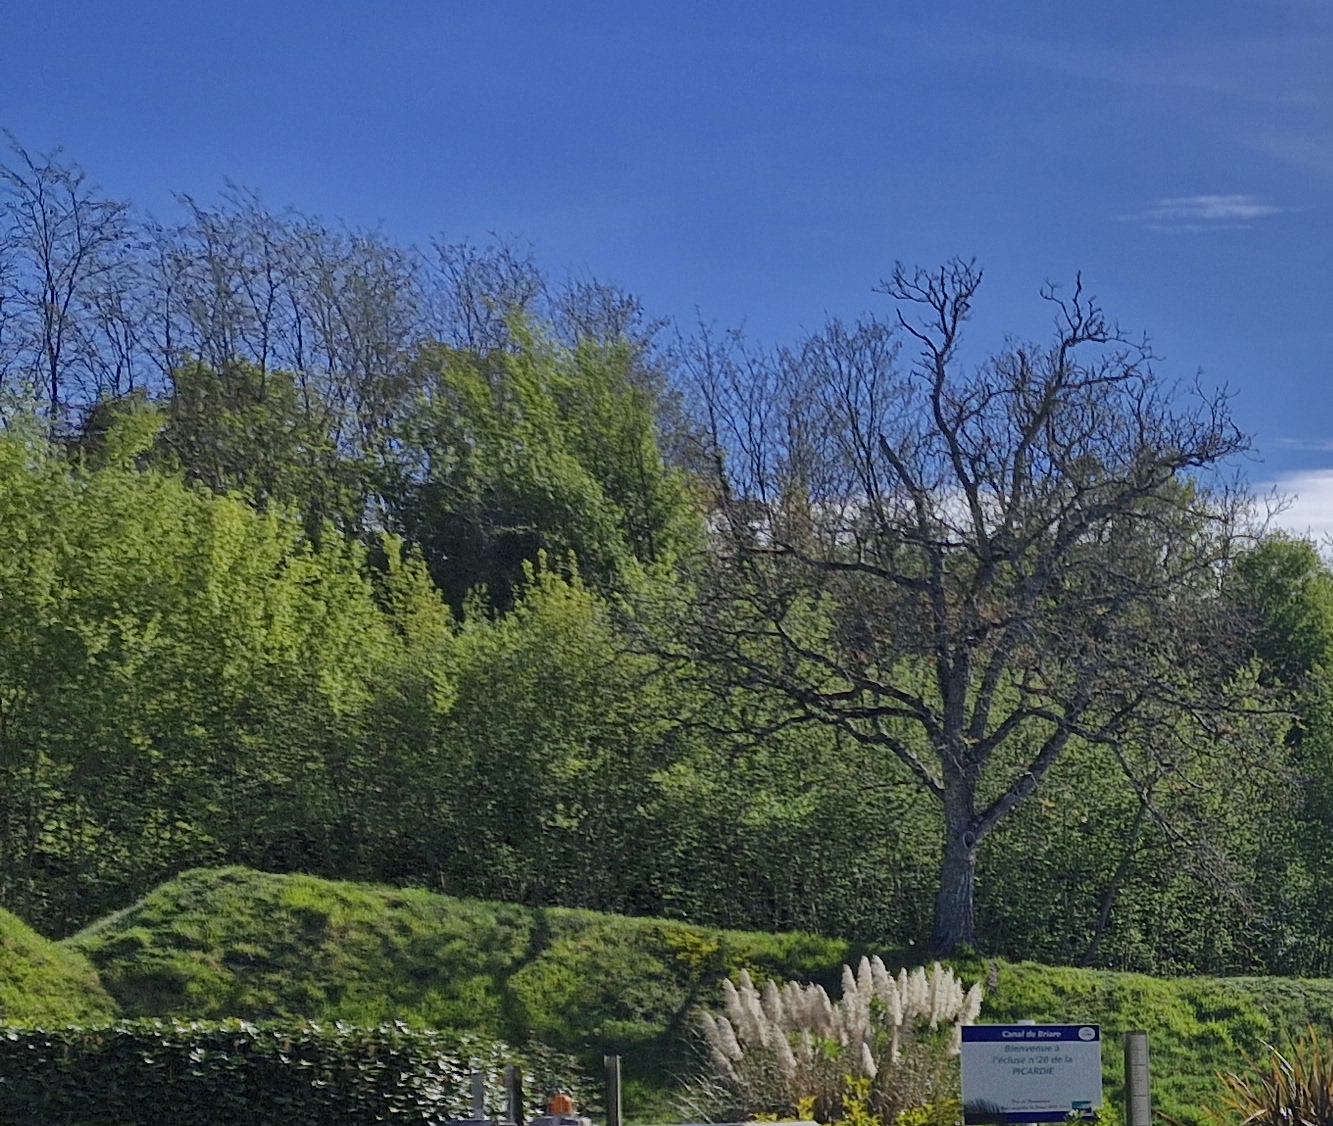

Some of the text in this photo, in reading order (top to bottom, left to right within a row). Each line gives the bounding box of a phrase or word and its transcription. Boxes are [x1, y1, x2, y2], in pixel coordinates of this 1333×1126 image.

[1001, 1030, 1062, 1039] Canal de Briare
[1004, 1045, 1053, 1053] Bienvenue
[1050, 1055, 1062, 1064] de
[1064, 1055, 1073, 1064] la
[1012, 1067, 1055, 1076] PICARDIE
